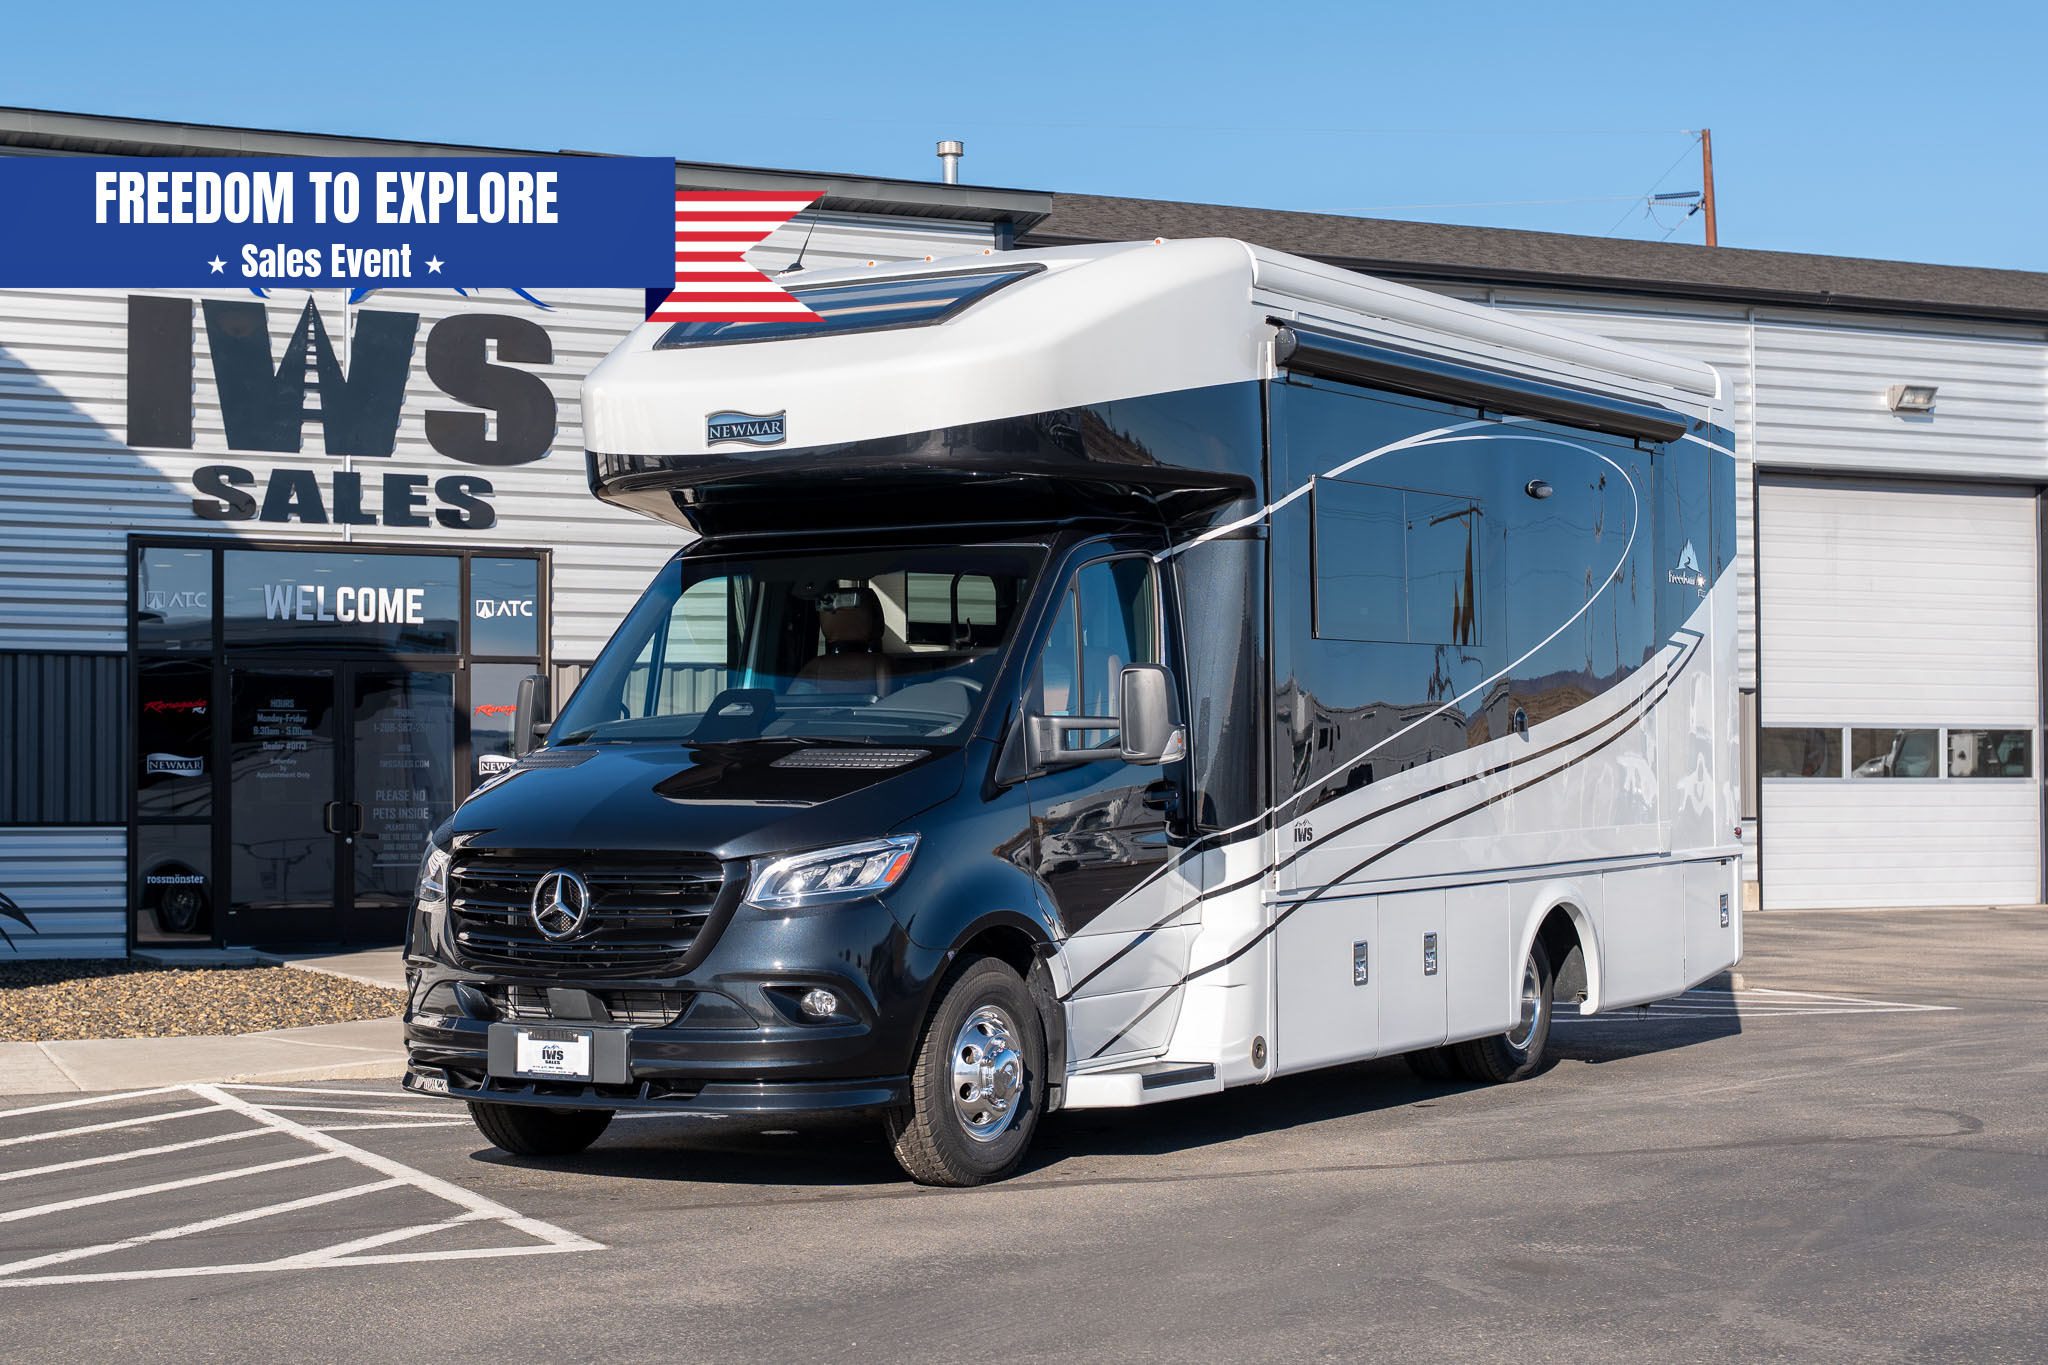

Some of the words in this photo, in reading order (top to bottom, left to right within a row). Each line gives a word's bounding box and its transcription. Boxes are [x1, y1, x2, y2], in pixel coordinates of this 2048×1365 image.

[127, 294, 557, 466] IWS
[709, 421, 783, 439] NEWMAR
[192, 465, 497, 530] SALES
[168, 591, 207, 608] ATC
[264, 583, 425, 624] WELCOME
[496, 600, 533, 617] ATC
[270, 698, 296, 708] HOURS
[149, 760, 201, 770] NEWMAR
[375, 789, 409, 801] PLEASE
[412, 789, 426, 801] NO
[373, 807, 396, 820] PETS
[399, 807, 429, 820] INSIDE
[1294, 827, 1313, 842] IWS
[146, 873, 204, 884] rossmönster
[542, 1049, 564, 1061] IWS
